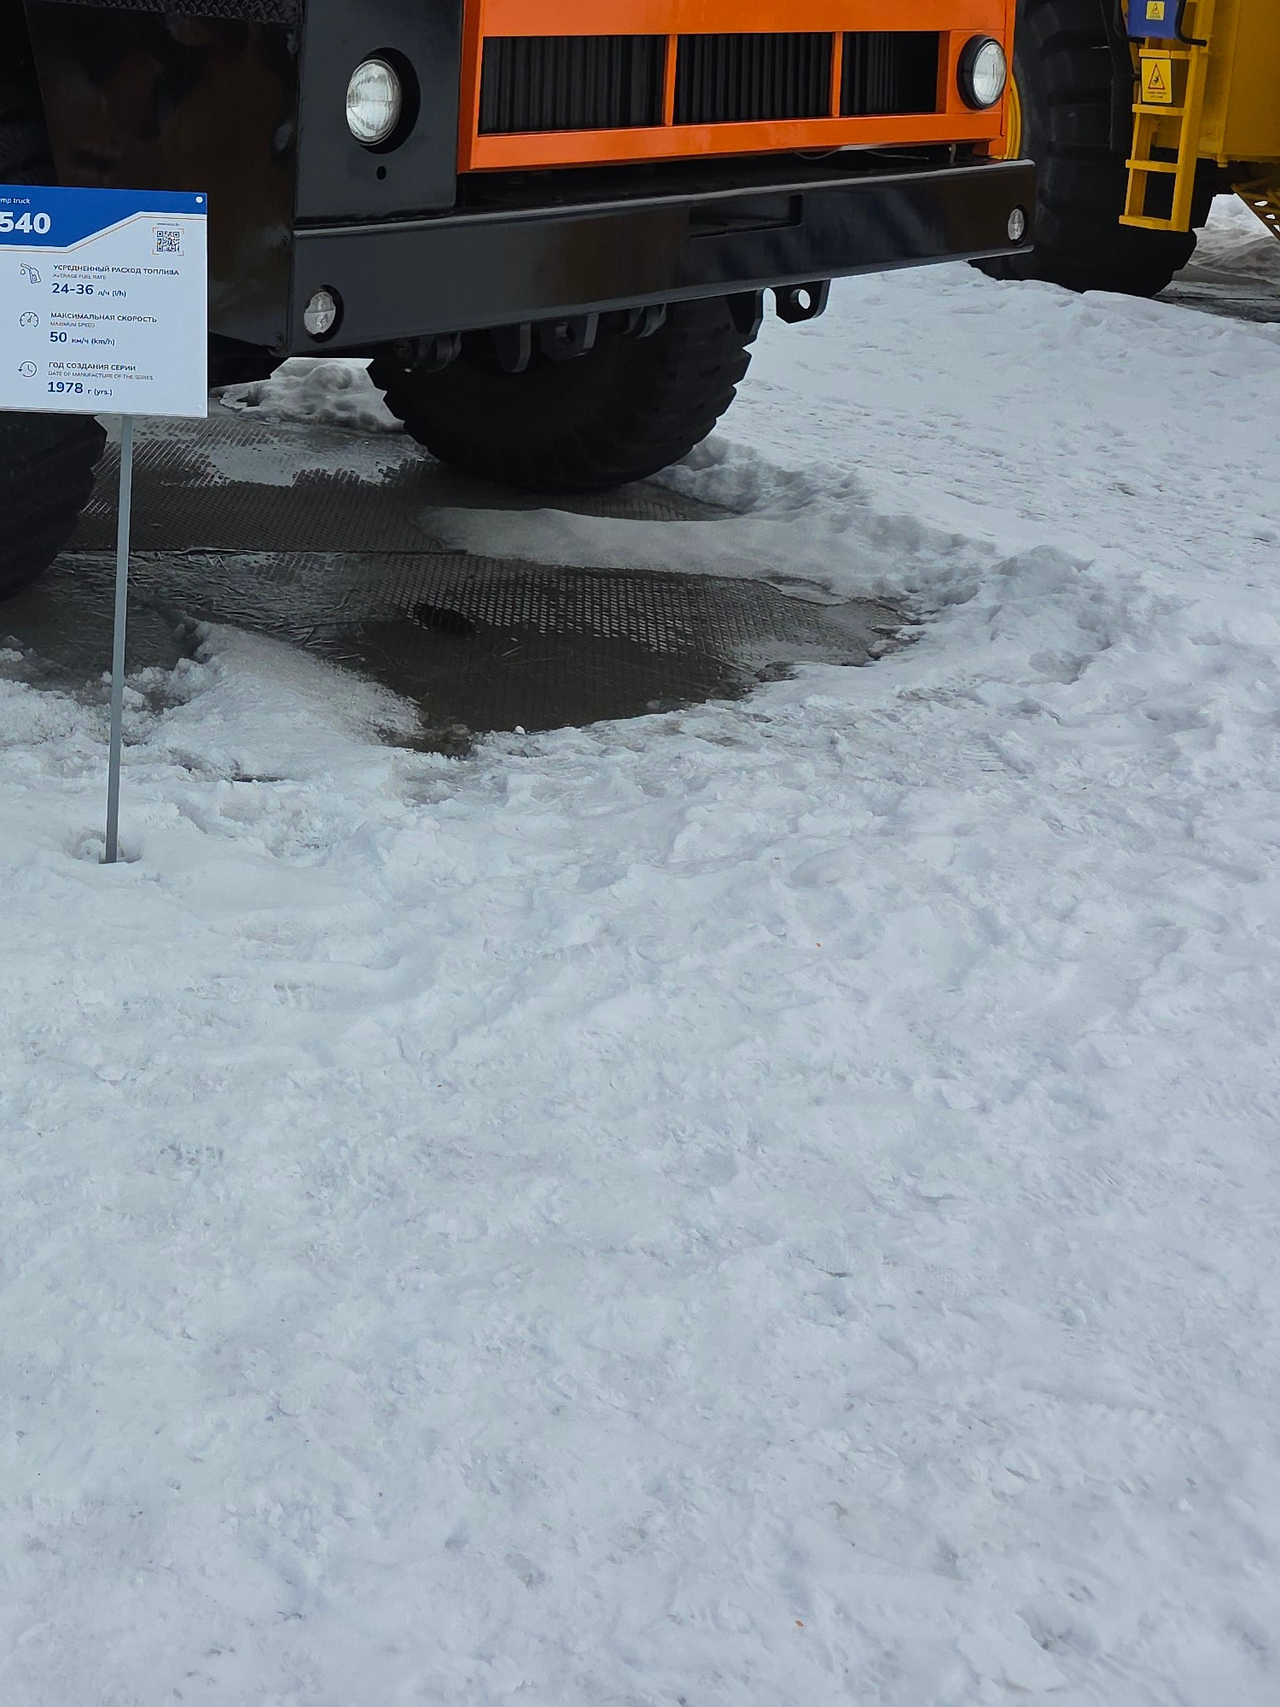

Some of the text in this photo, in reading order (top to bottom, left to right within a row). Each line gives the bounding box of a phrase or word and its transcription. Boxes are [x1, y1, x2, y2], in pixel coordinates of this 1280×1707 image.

[53, 264, 180, 276] УСРЕДНЕННЫЙ РАСХОД ТОПЛИВА
[52, 283, 94, 295] 24-36
[50, 312, 157, 323] МАКСИМАЛЬНАЯ СКОРОСТЬ
[49, 331, 67, 343] 50
[91, 337, 115, 346] (km/h)
[48, 362, 65, 370] ГОД
[47, 381, 84, 394] 1978
